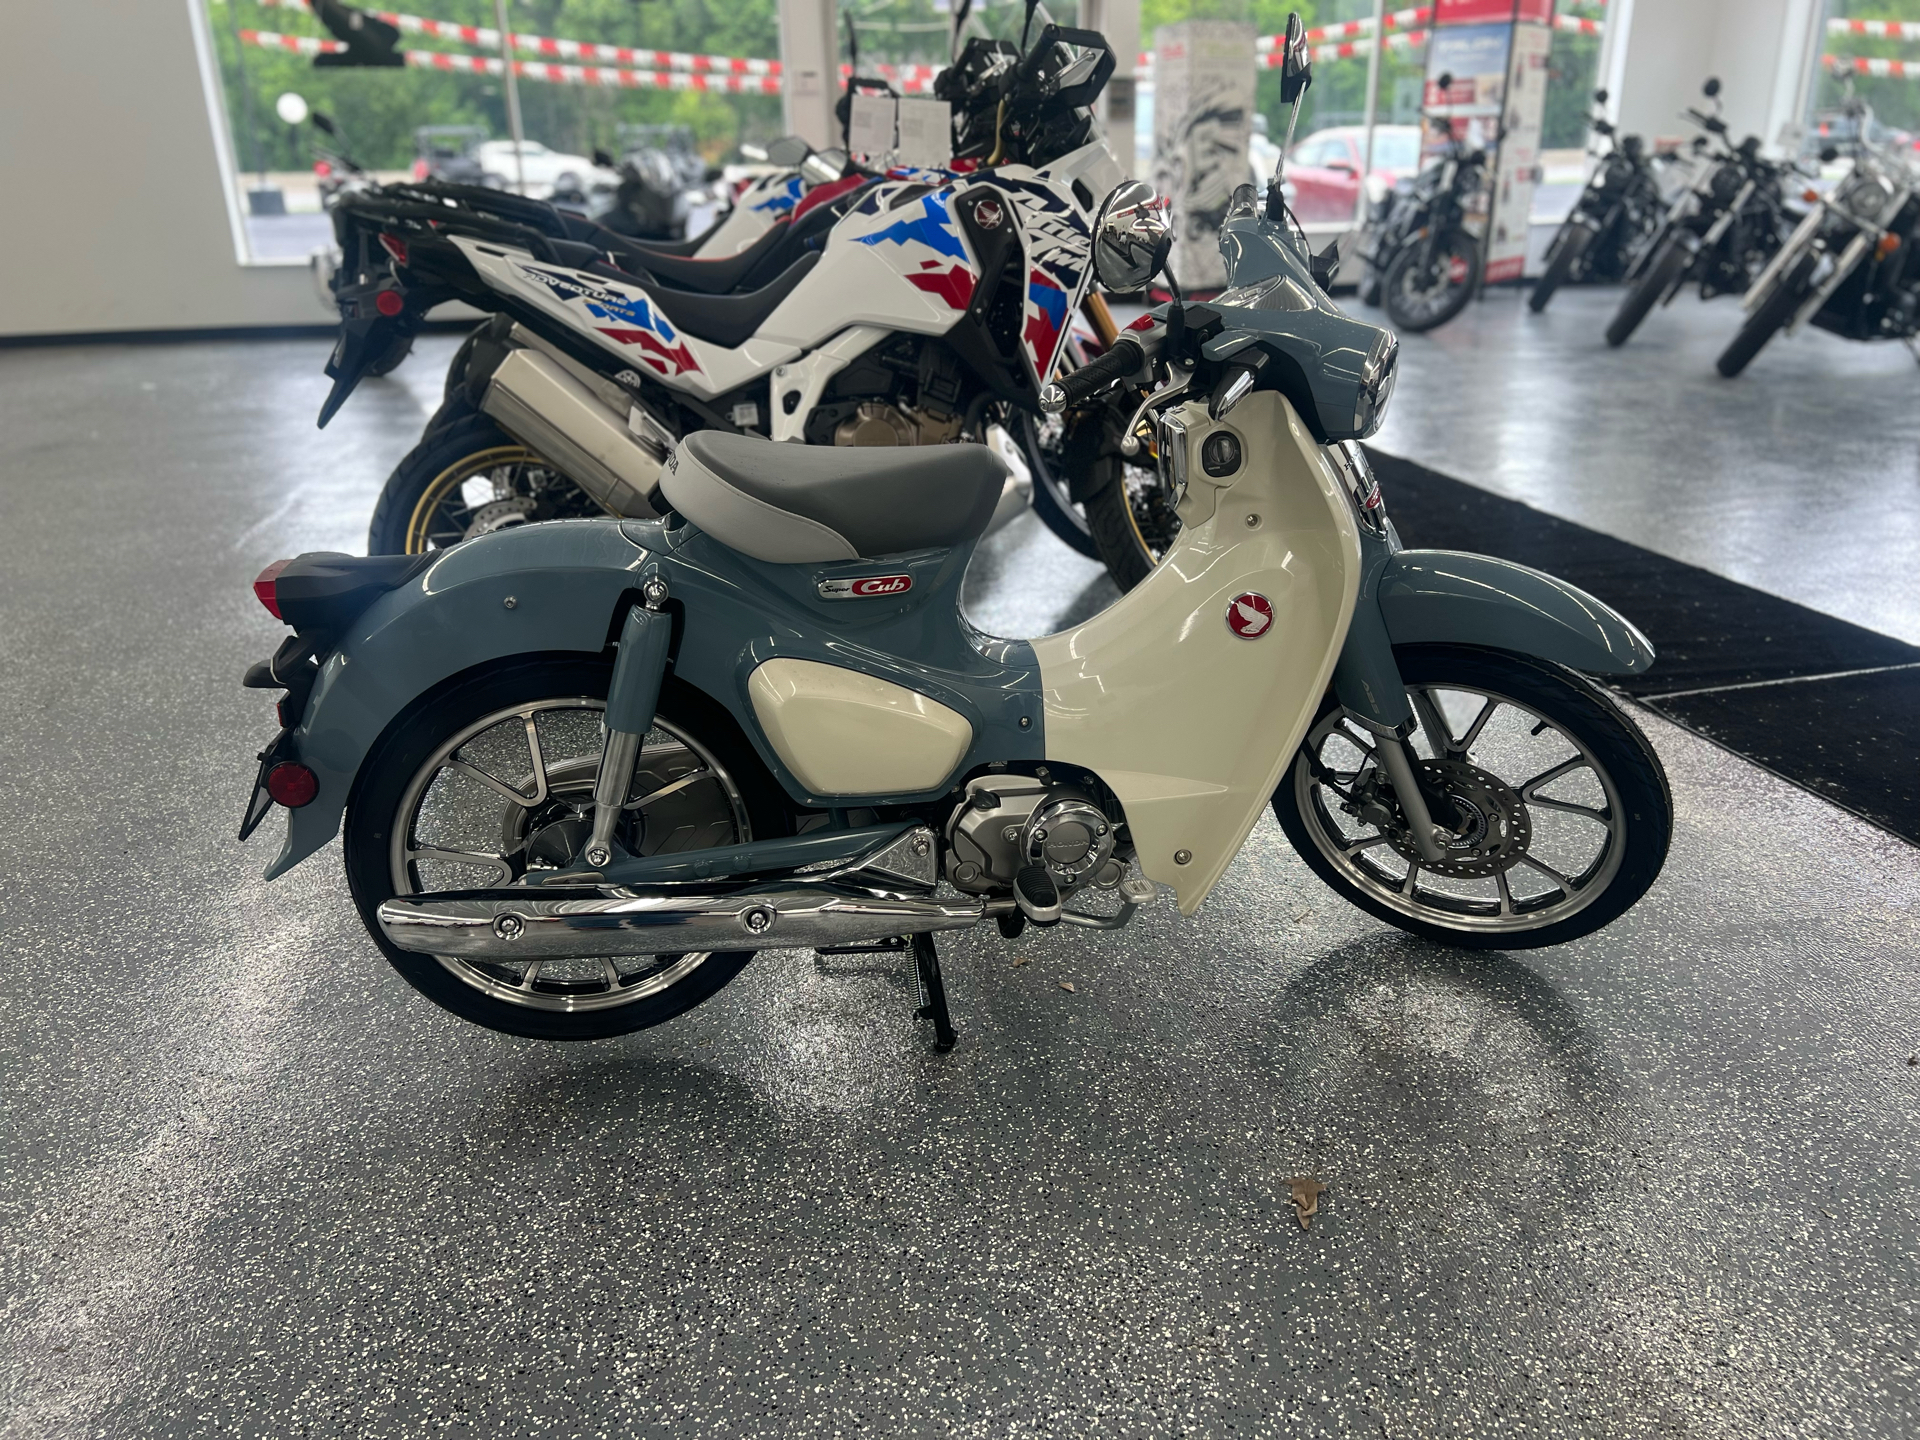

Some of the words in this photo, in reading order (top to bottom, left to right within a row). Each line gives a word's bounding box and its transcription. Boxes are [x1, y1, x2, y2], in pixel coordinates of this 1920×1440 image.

[523, 273, 629, 306] ADVENTURE
[583, 298, 637, 318] SPORTS
[822, 585, 851, 594] Super
[860, 578, 905, 594] Cub
[1047, 839, 1090, 849] HONDA
